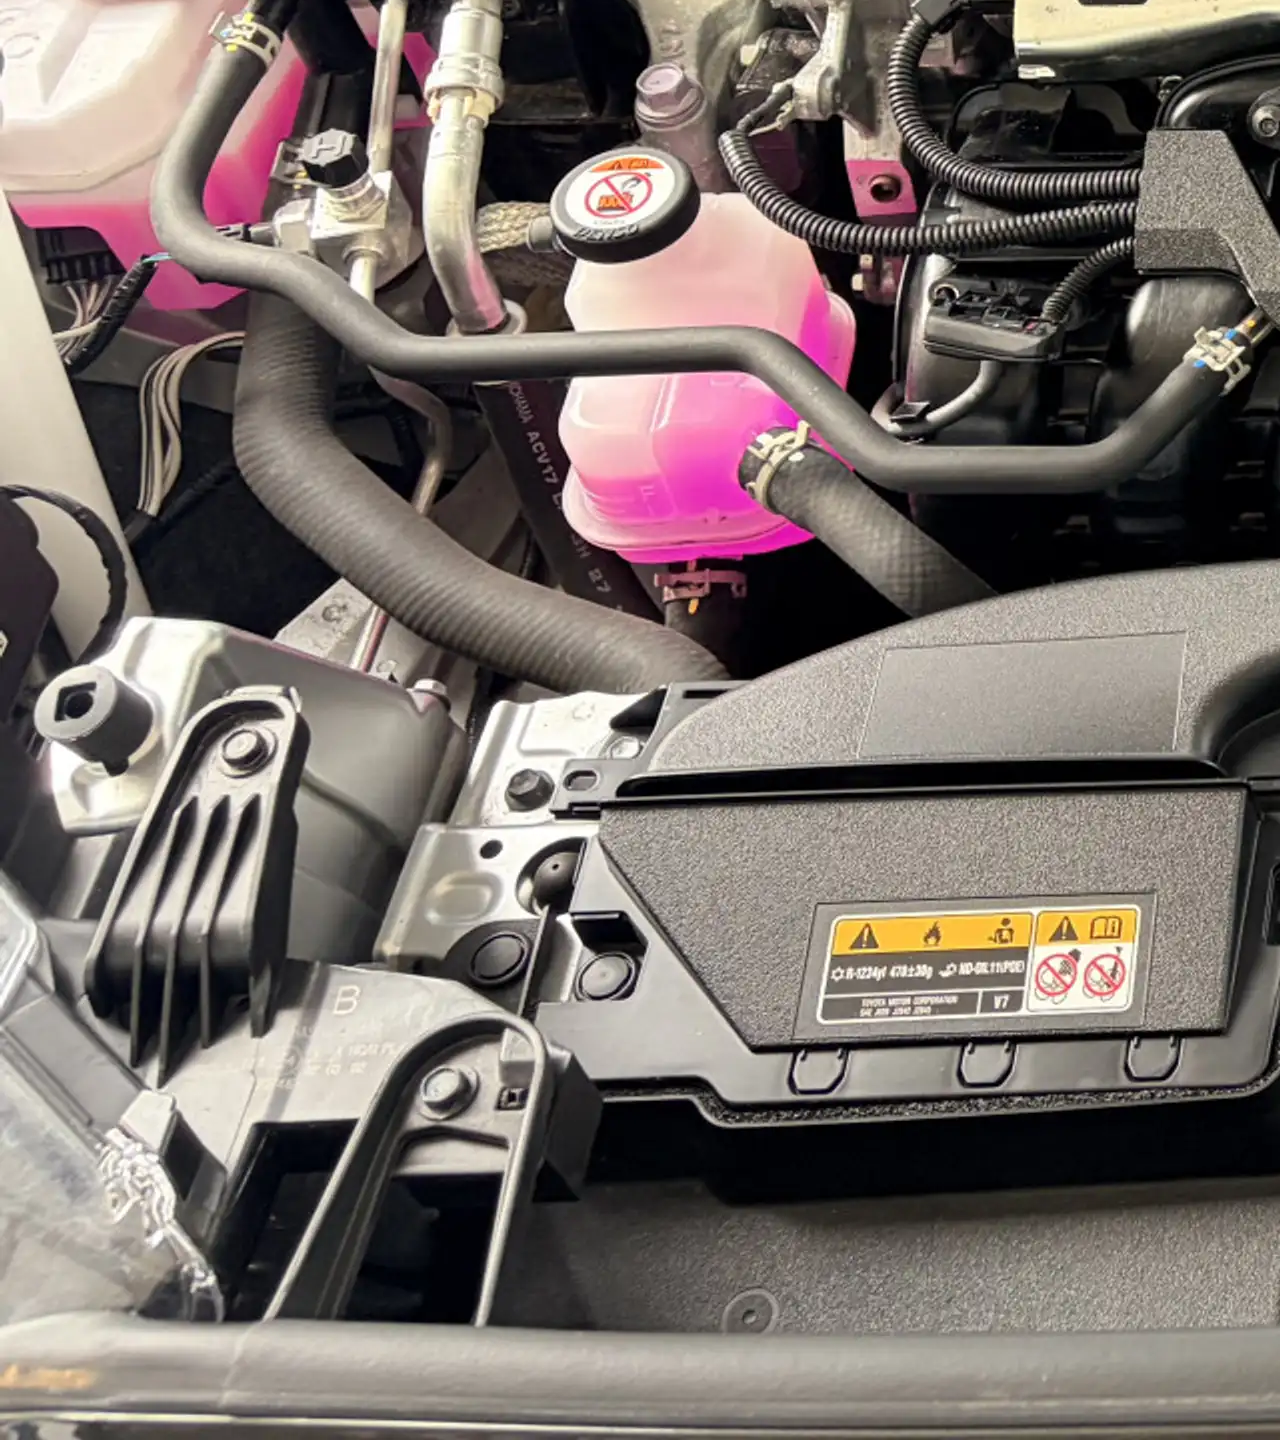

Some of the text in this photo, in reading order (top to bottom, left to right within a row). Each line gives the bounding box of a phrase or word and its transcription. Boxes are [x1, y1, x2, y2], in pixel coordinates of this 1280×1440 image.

[526, 430, 560, 485] ACV17
[332, 984, 361, 1015] B
[993, 994, 1011, 1009] V7
